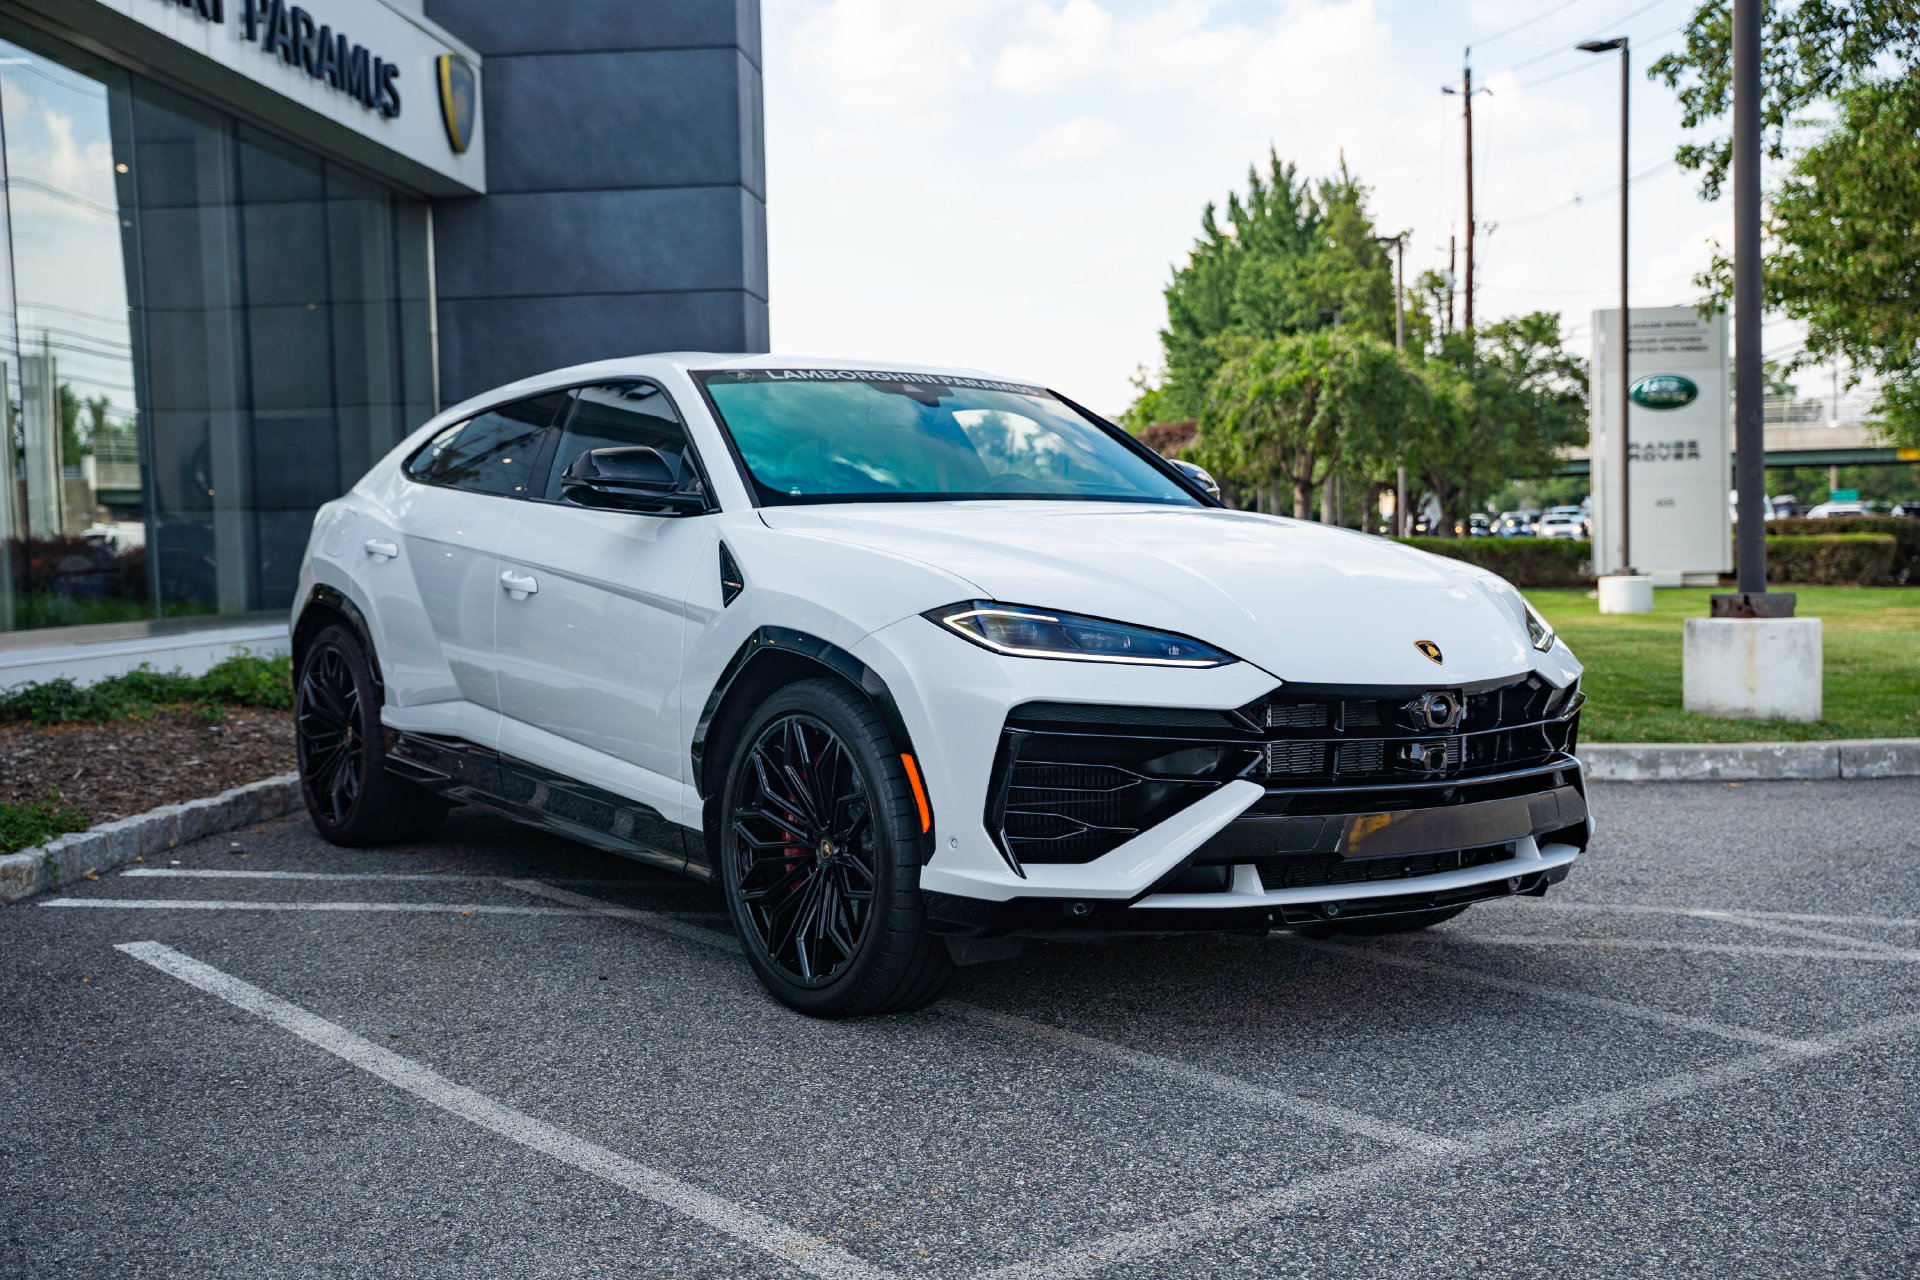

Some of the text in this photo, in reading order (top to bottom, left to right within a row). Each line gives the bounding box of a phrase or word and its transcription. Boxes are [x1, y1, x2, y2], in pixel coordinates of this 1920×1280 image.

[244, 0, 400, 117] PARAMUS
[765, 370, 1040, 396] LAMBORGHINI PARAMUS
